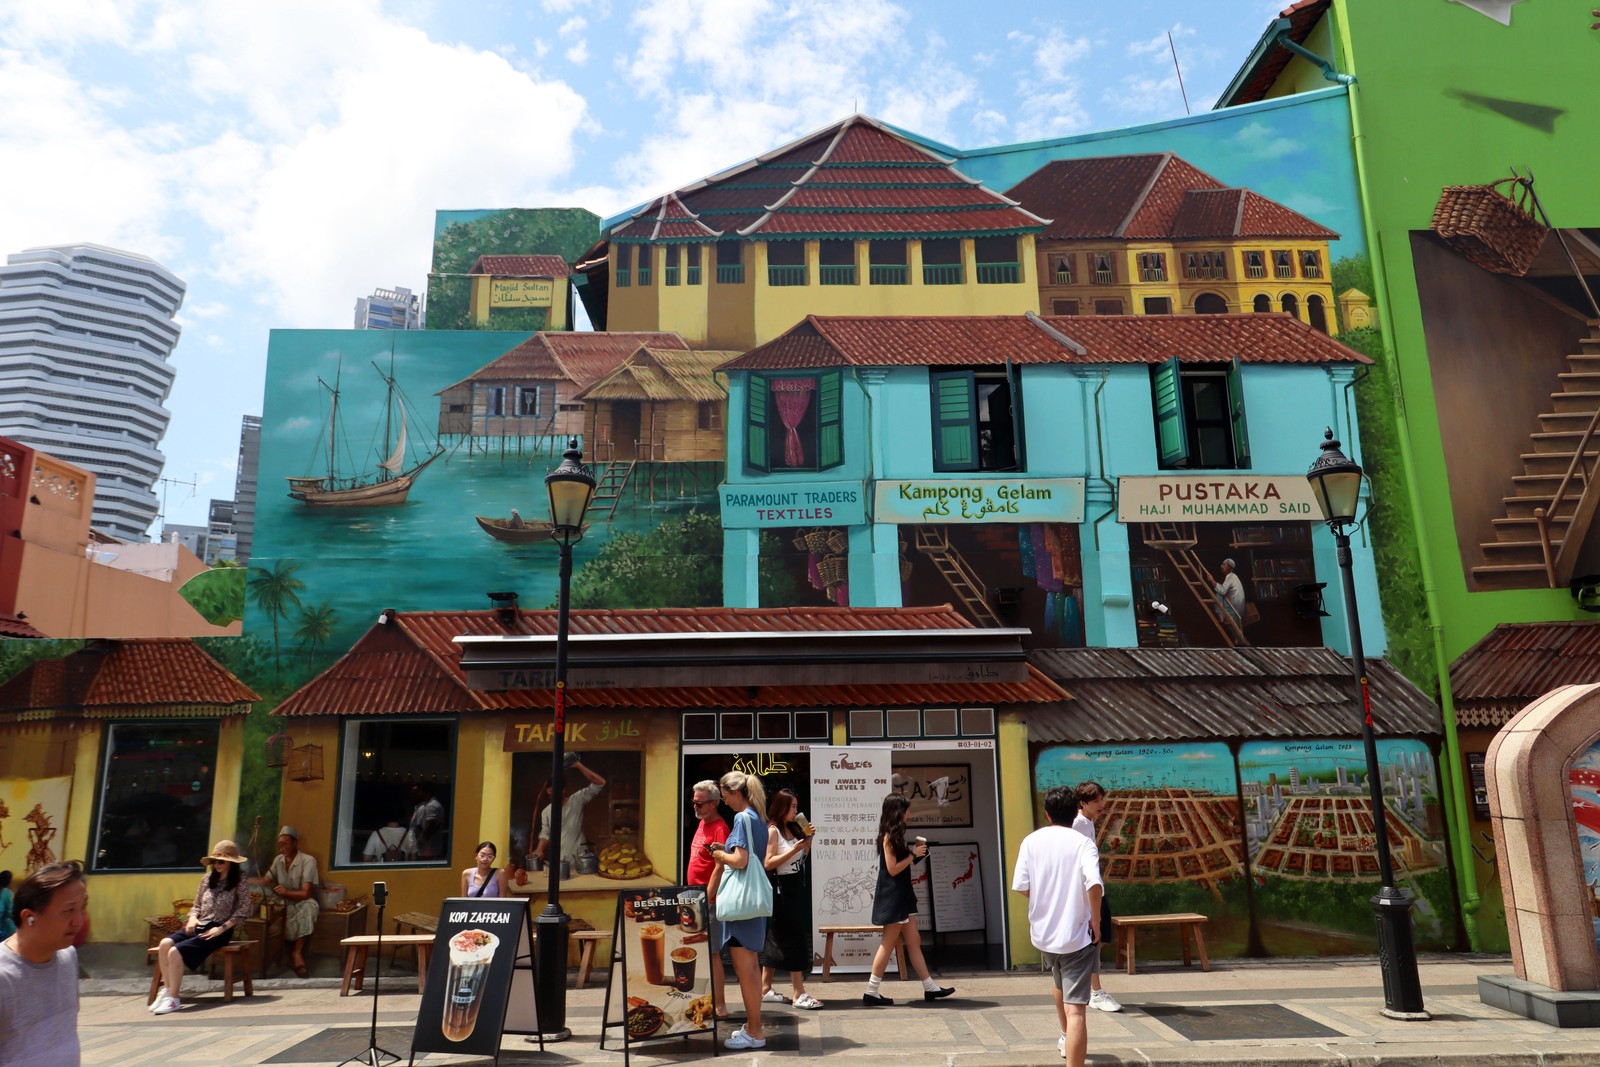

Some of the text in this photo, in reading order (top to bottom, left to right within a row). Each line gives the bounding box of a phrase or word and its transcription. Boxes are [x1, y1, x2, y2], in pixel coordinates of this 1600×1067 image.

[494, 282, 549, 293] Masjid Sultan
[494, 293, 550, 304] مسجد سلطان
[899, 482, 1052, 503] Kampong Gelam
[1159, 482, 1281, 501] PUSTAKA
[725, 491, 857, 507] PARAMOUNT TRADERS
[756, 508, 833, 521] TEXTILES
[1140, 502, 1312, 516] HAJI MUHAMMAD SAID
[595, 719, 640, 742] طارق
[854, 850, 879, 862] WELCO
[634, 897, 697, 908] BESTSELLER
[448, 911, 511, 924] KOPI ZAFFRAN
